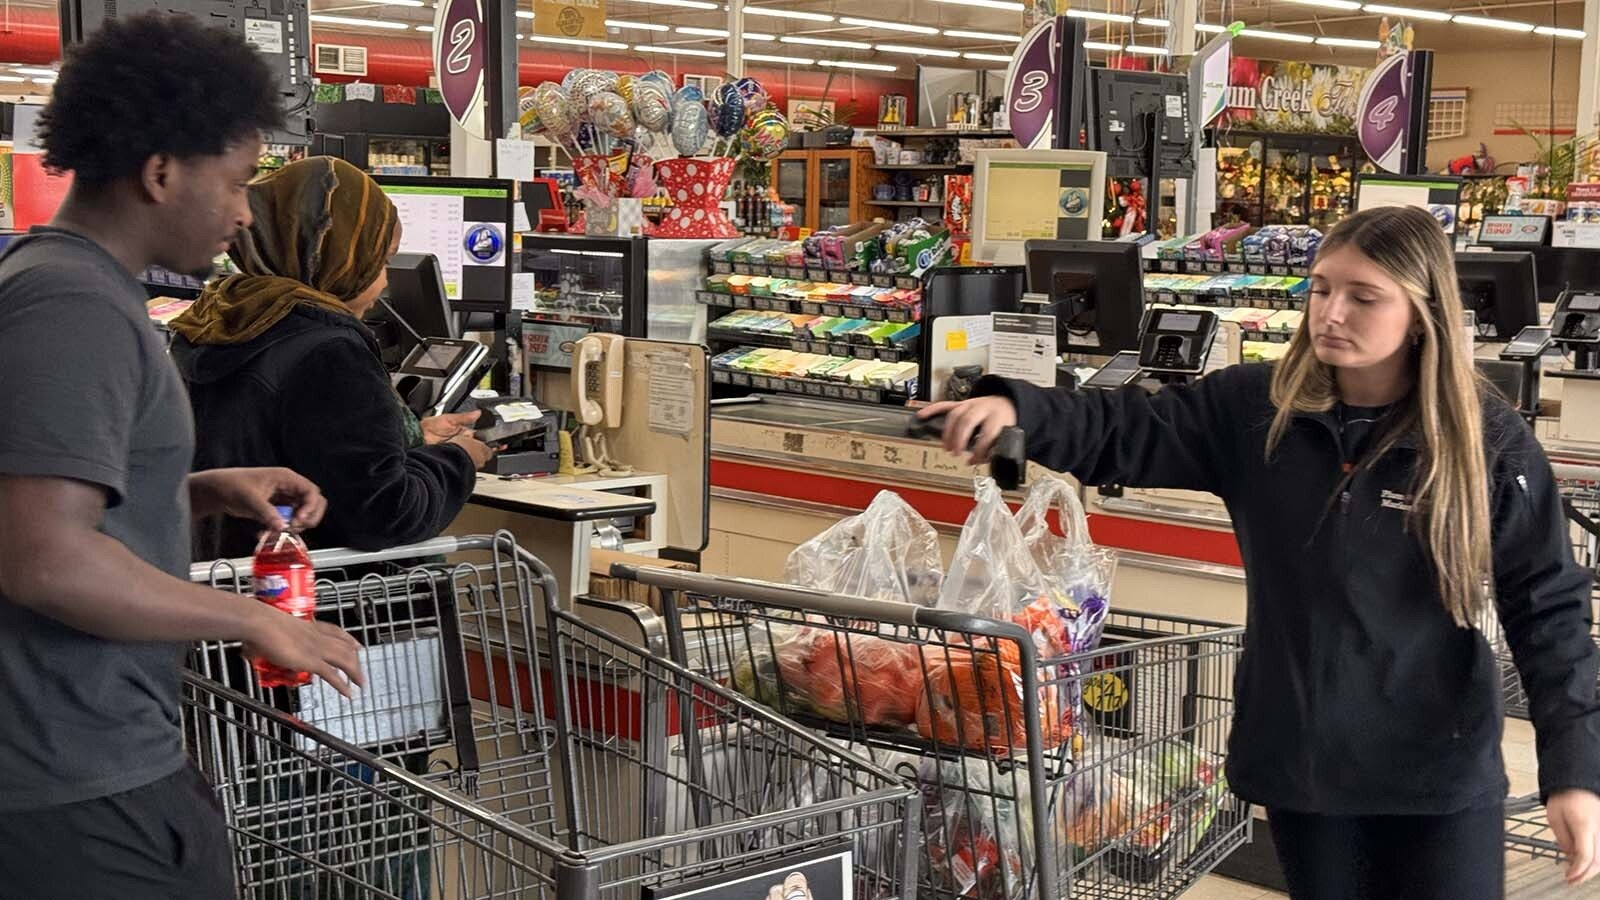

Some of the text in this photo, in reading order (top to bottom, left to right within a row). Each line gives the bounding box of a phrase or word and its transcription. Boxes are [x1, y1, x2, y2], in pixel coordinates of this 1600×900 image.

[447, 18, 475, 74] 2
[1014, 70, 1049, 112] 3
[1261, 75, 1313, 113] Creek
[1368, 95, 1399, 131] 4
